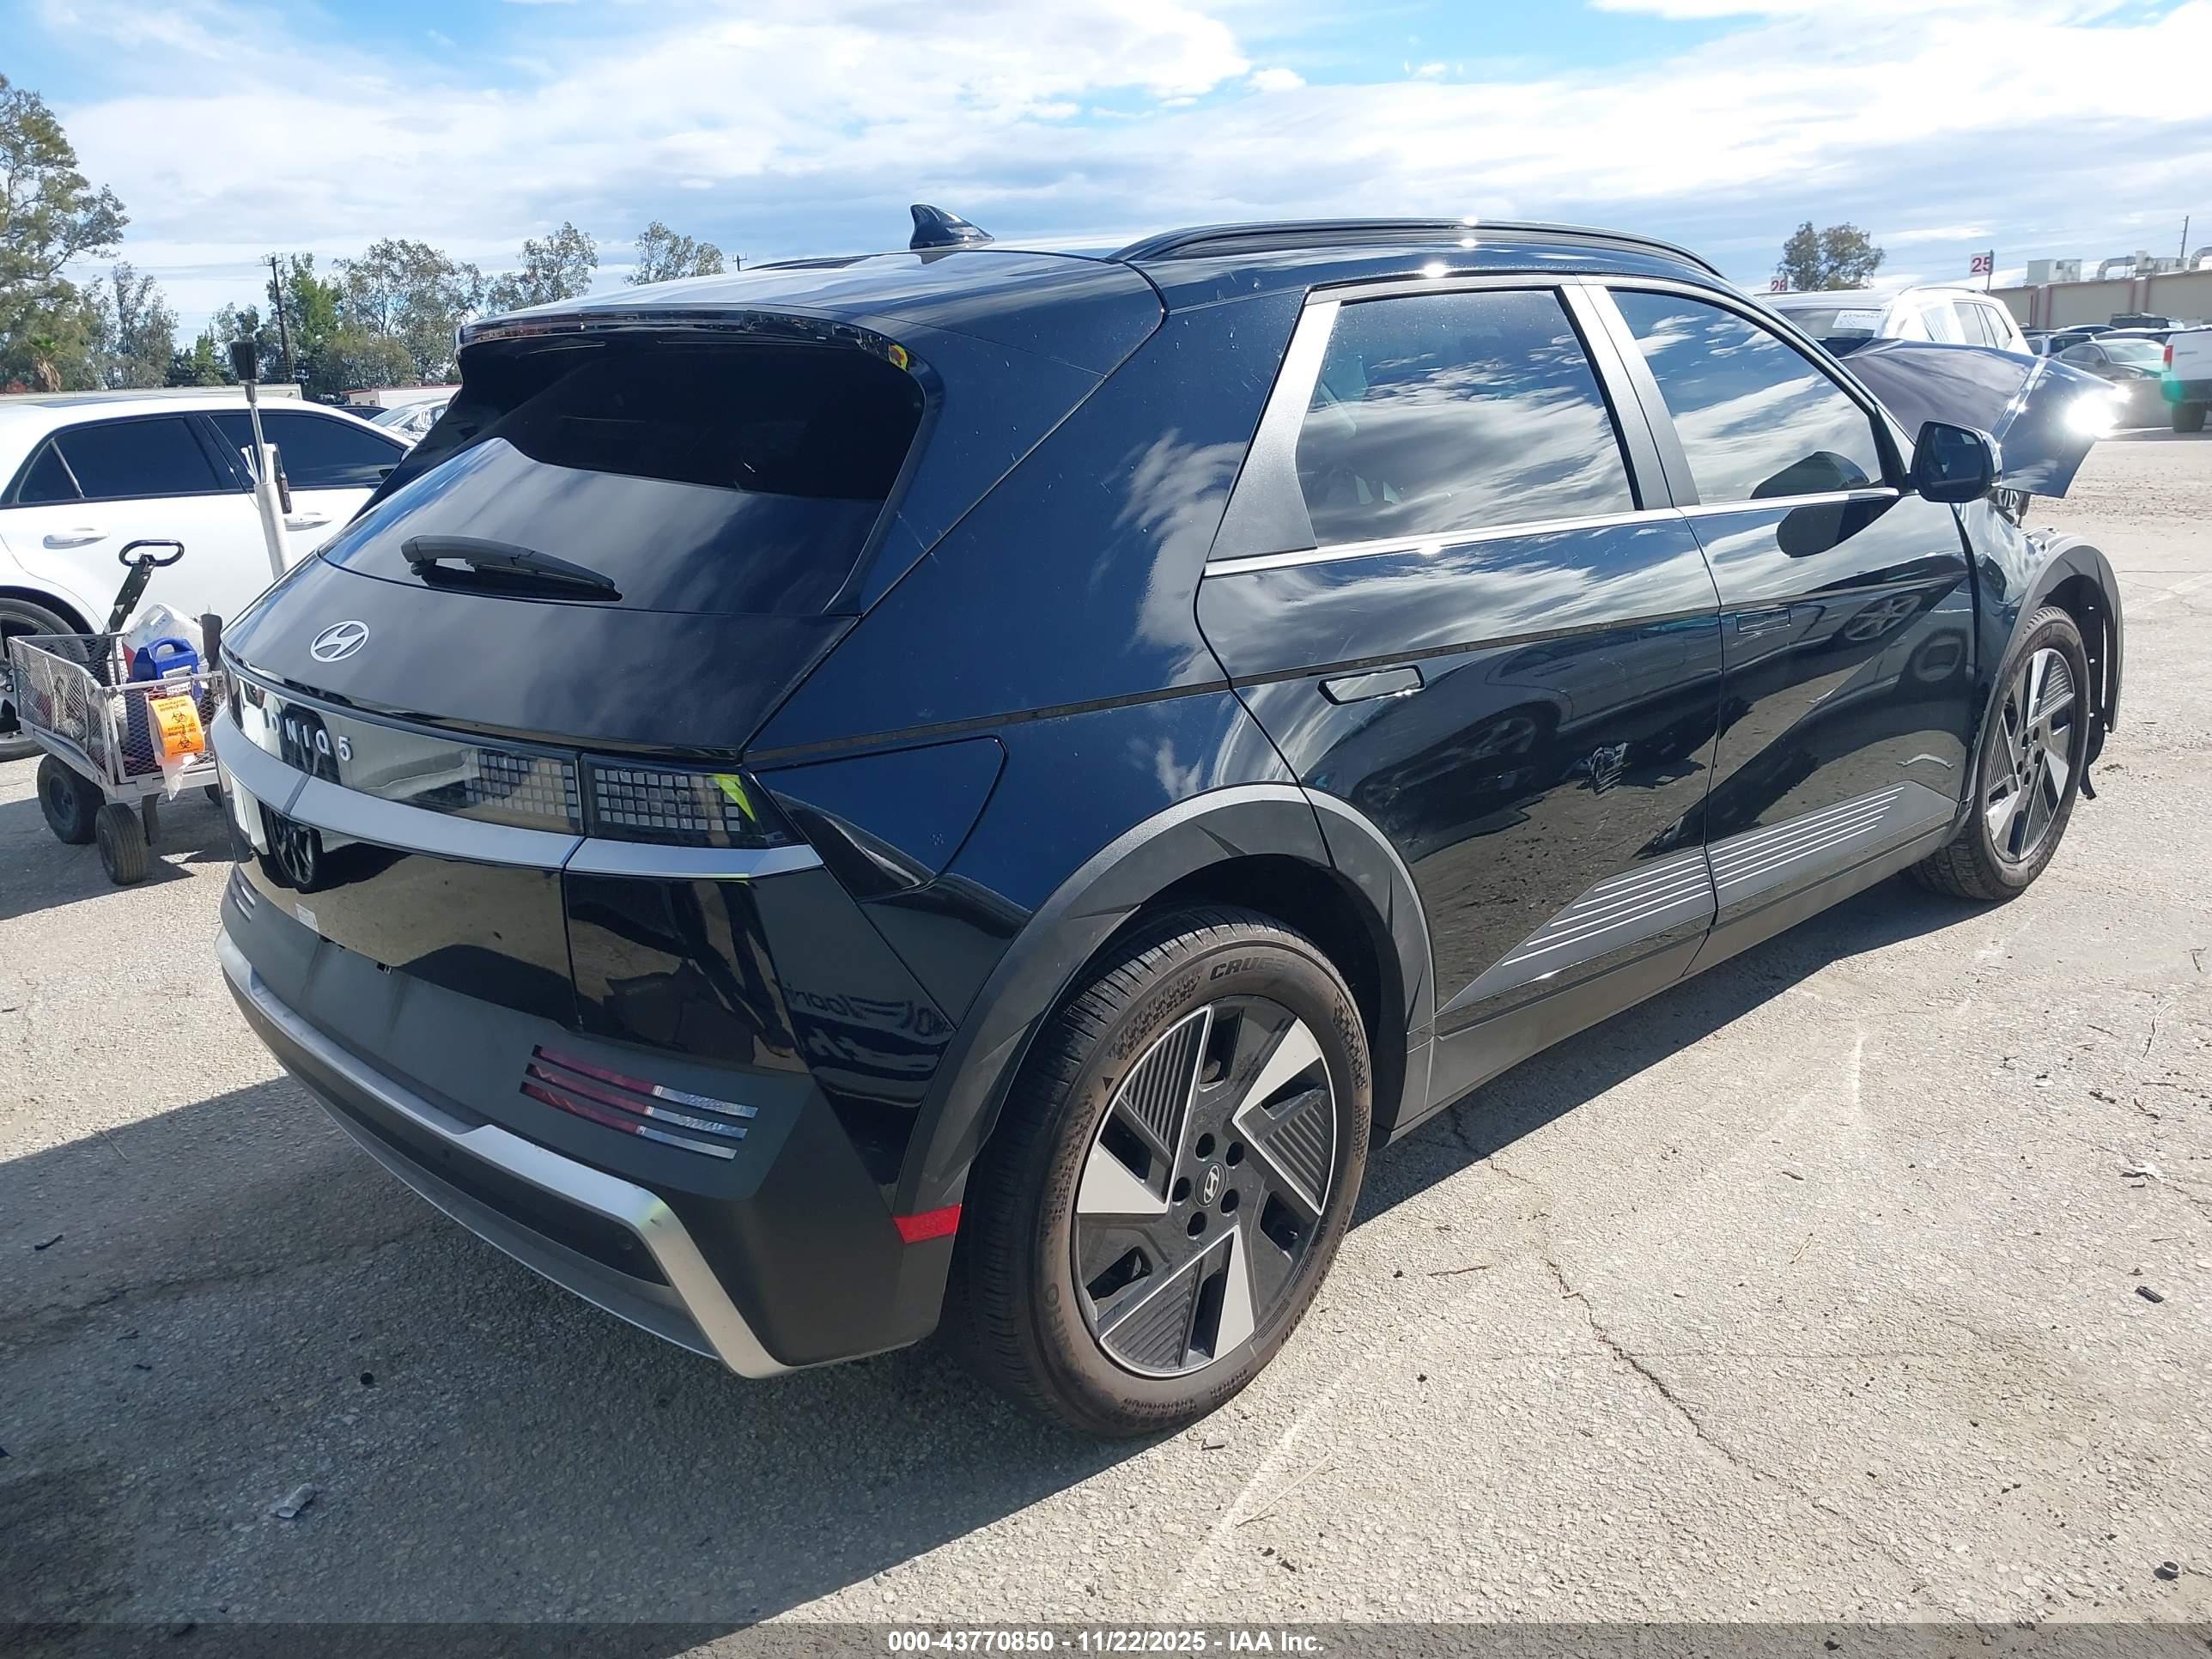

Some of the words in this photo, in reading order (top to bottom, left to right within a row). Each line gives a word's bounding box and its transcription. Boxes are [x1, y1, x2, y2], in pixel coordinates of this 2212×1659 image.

[1972, 257, 1990, 272] 25
[263, 707, 330, 756] IONIQ
[337, 736, 352, 762] 5
